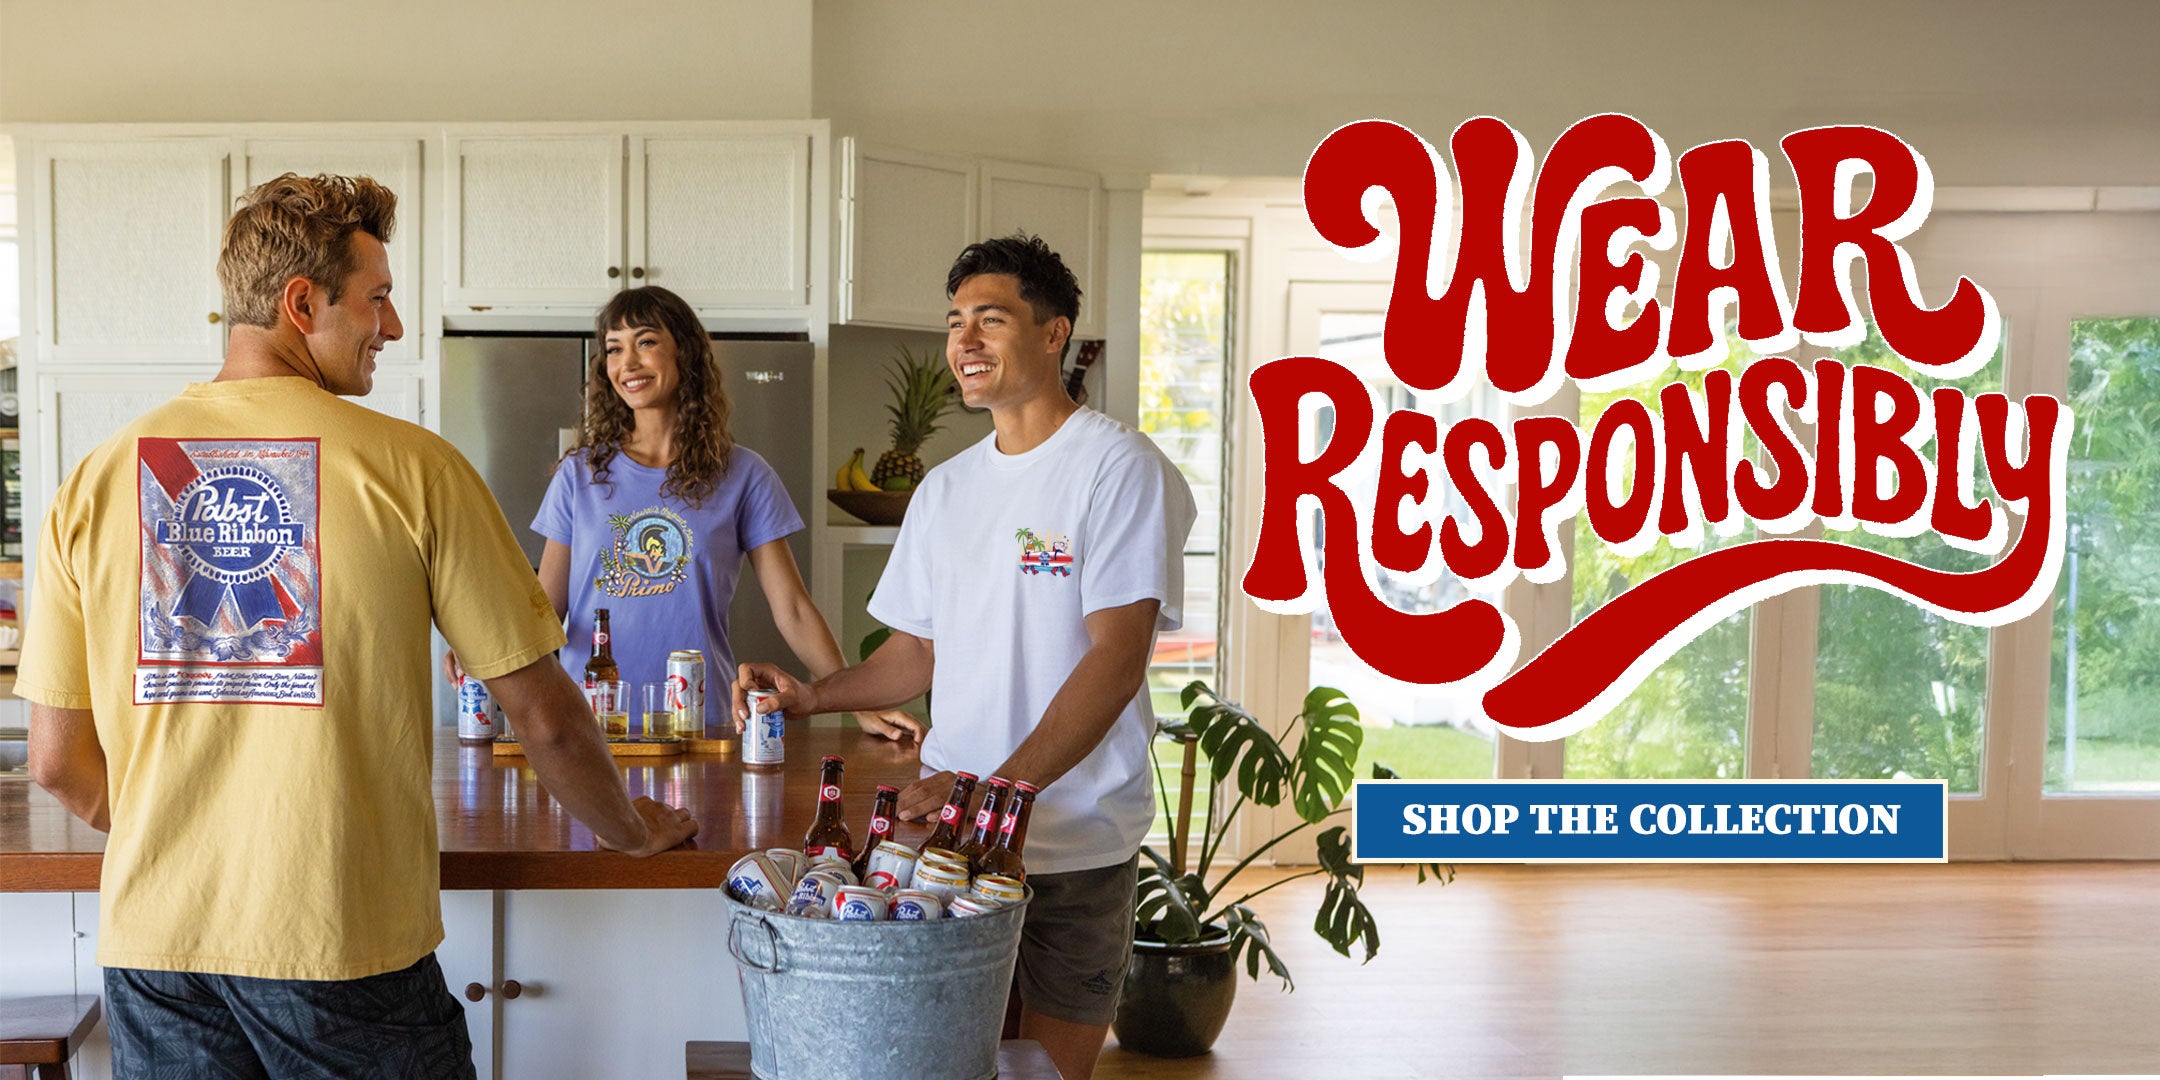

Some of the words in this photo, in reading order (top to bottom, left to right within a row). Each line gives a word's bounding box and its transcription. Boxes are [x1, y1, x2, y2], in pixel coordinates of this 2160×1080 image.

[191, 485, 270, 523] Pabst
[165, 521, 216, 543] Blue
[217, 522, 296, 546] Ribbon
[213, 546, 251, 558] BEER
[618, 570, 675, 598] Primo
[896, 905, 921, 919] Pabst
